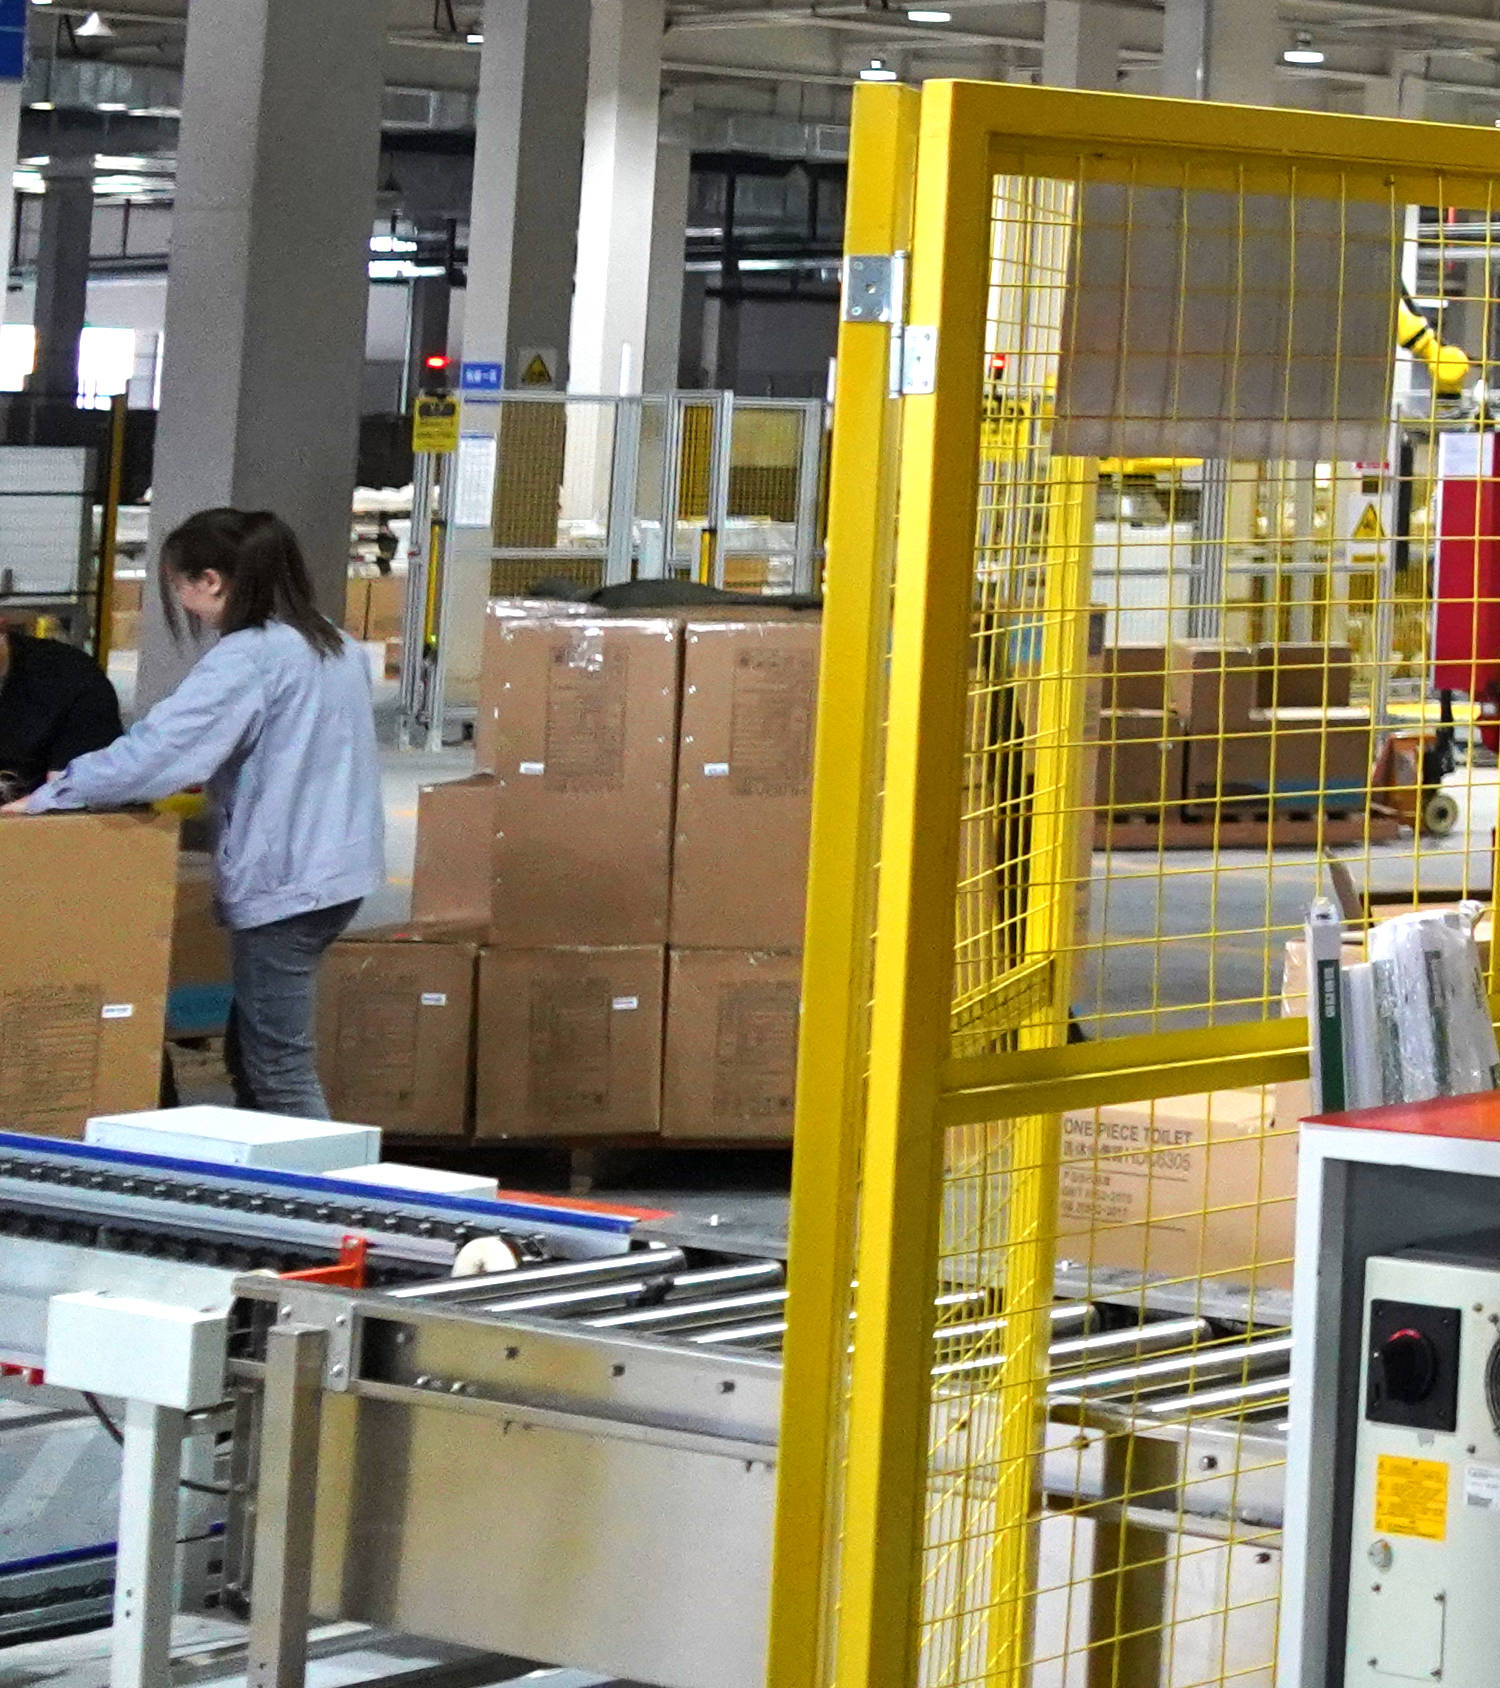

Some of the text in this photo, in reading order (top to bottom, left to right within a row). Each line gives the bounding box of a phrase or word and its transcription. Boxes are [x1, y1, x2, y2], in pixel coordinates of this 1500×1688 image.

[1064, 1118, 1194, 1145] ONE PIECE TOILET
